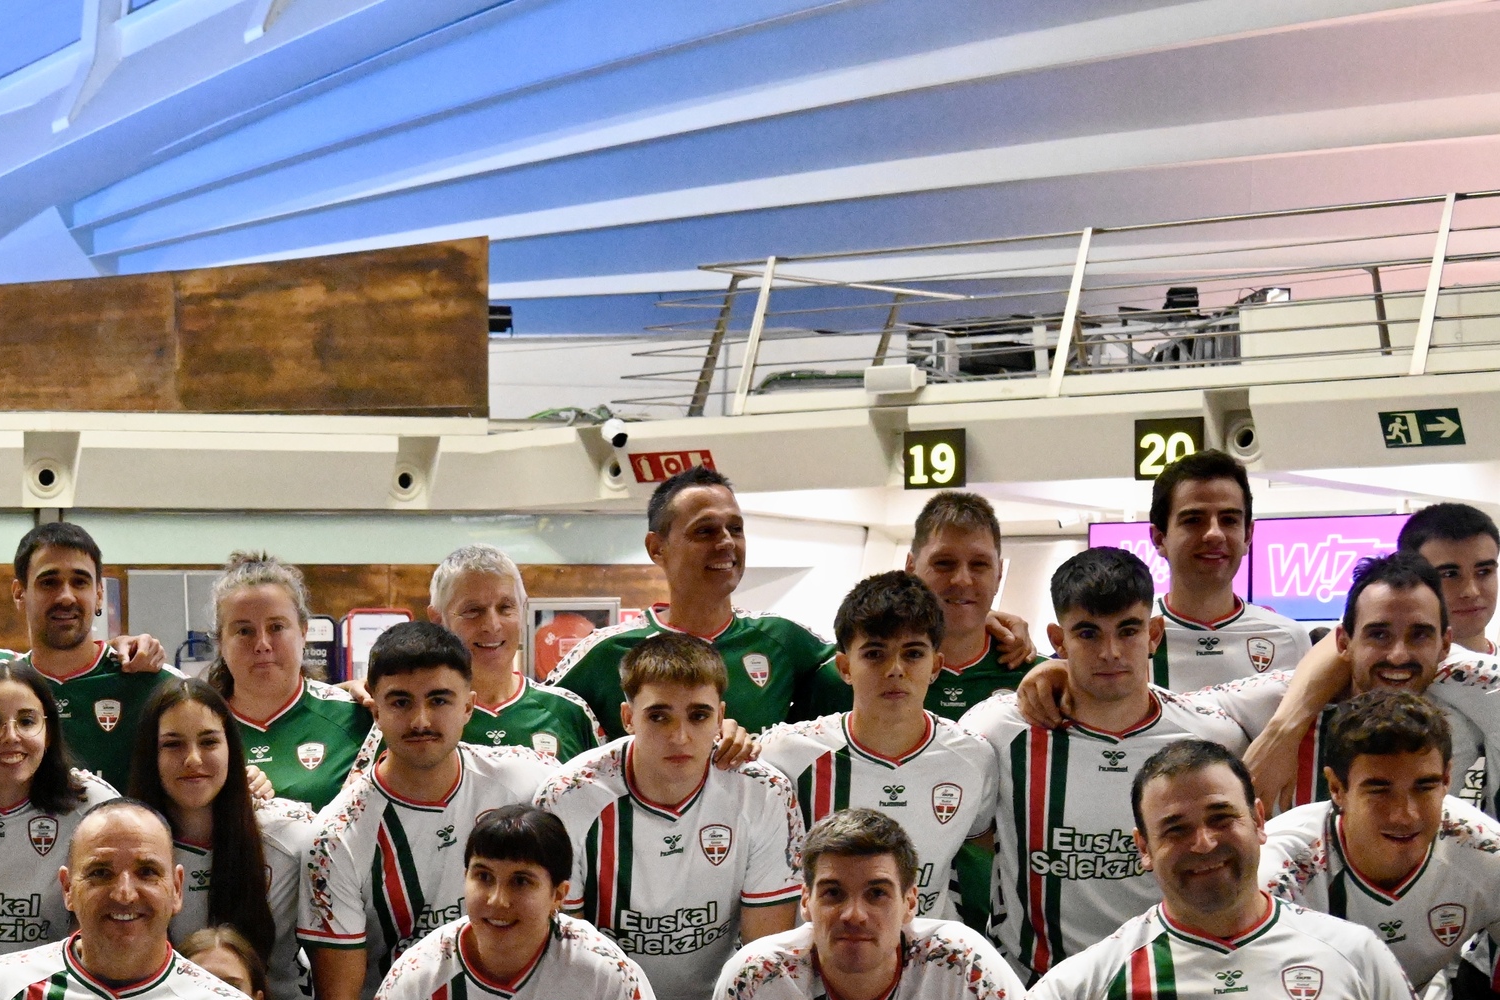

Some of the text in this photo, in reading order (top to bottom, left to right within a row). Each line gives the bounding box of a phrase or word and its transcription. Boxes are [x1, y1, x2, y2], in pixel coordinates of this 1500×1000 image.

[909, 443, 956, 484] 19
[1140, 432, 1195, 475] 20
[1052, 827, 1140, 860] Euska
[1030, 851, 1145, 880] Selekzio
[620, 902, 718, 934] Euskal
[1213, 985, 1248, 995] hummel
